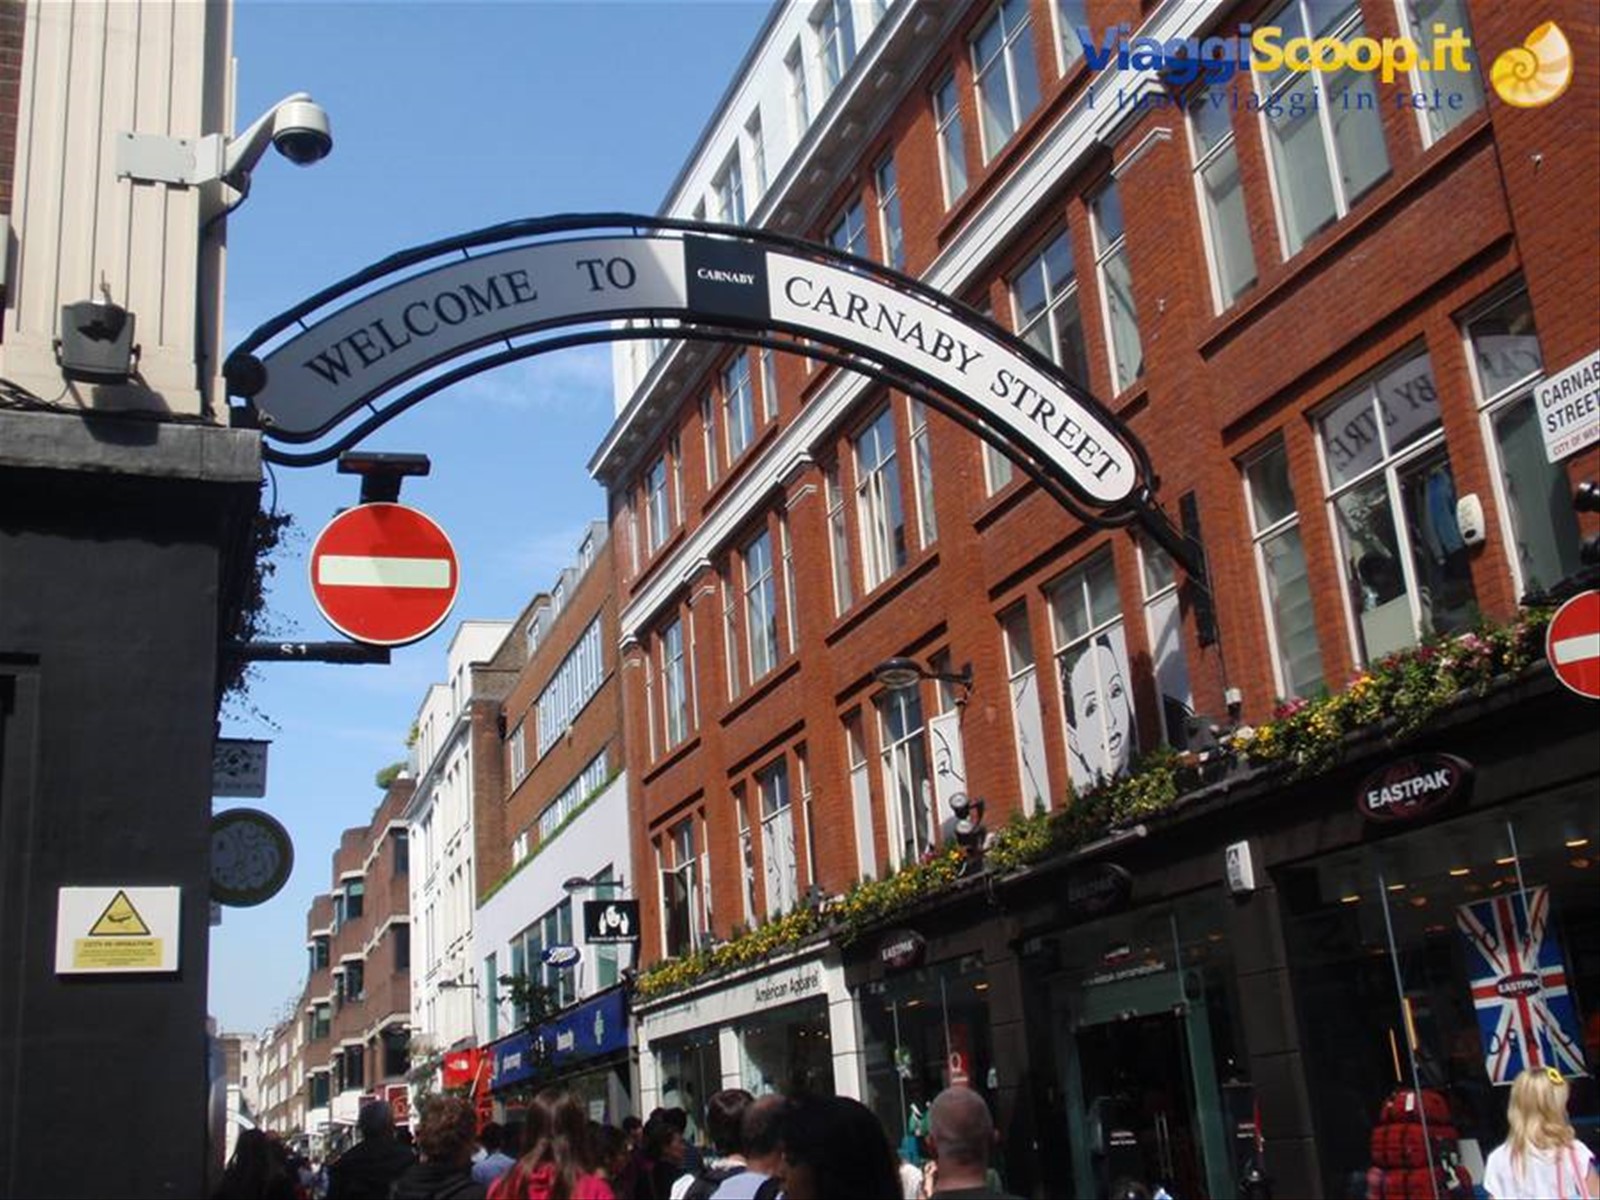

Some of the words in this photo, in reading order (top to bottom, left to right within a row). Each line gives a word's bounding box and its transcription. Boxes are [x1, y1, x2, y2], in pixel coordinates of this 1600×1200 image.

[697, 267, 755, 285] CARNABY
[303, 269, 538, 386] WELCOME
[576, 257, 636, 291] TO
[784, 276, 984, 376] CARNABY
[989, 368, 1122, 482] STREET
[1541, 361, 1600, 409] CARNAB
[1367, 768, 1451, 809] EASTPAK
